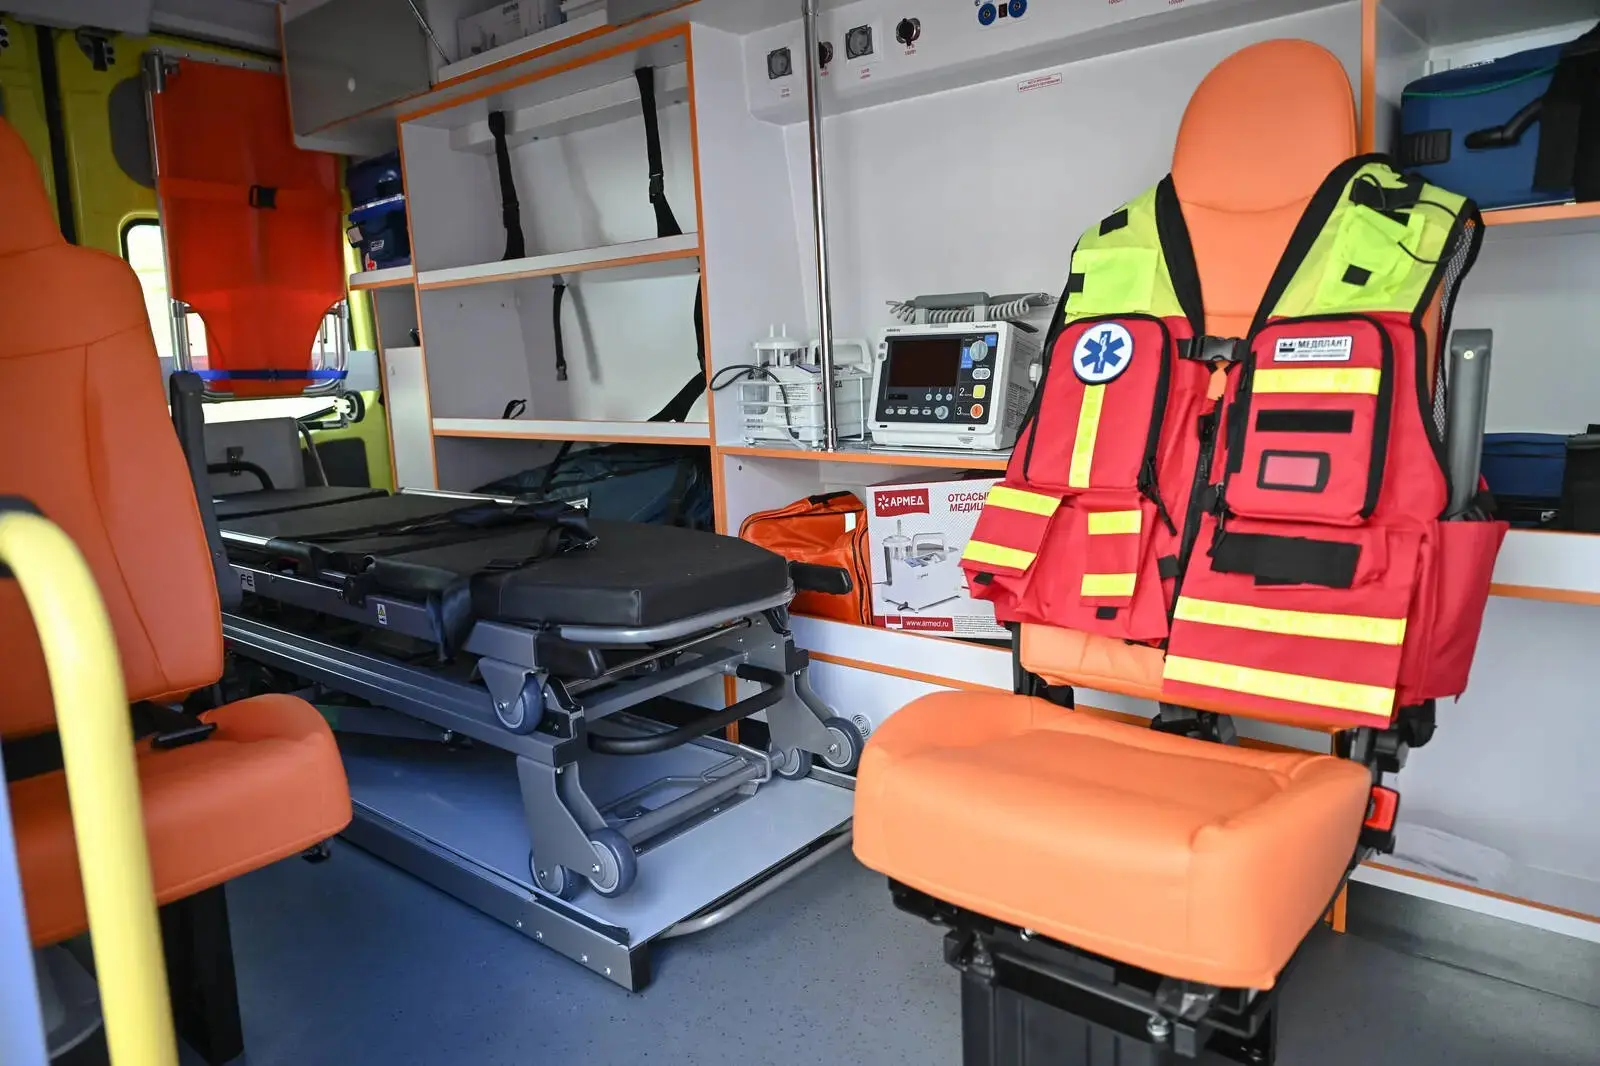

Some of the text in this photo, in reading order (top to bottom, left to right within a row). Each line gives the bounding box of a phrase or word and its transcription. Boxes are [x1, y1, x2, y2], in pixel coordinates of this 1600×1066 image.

[959, 387, 965, 396] 2
[956, 406, 962, 416] 3
[890, 495, 924, 507] АРМЕД
